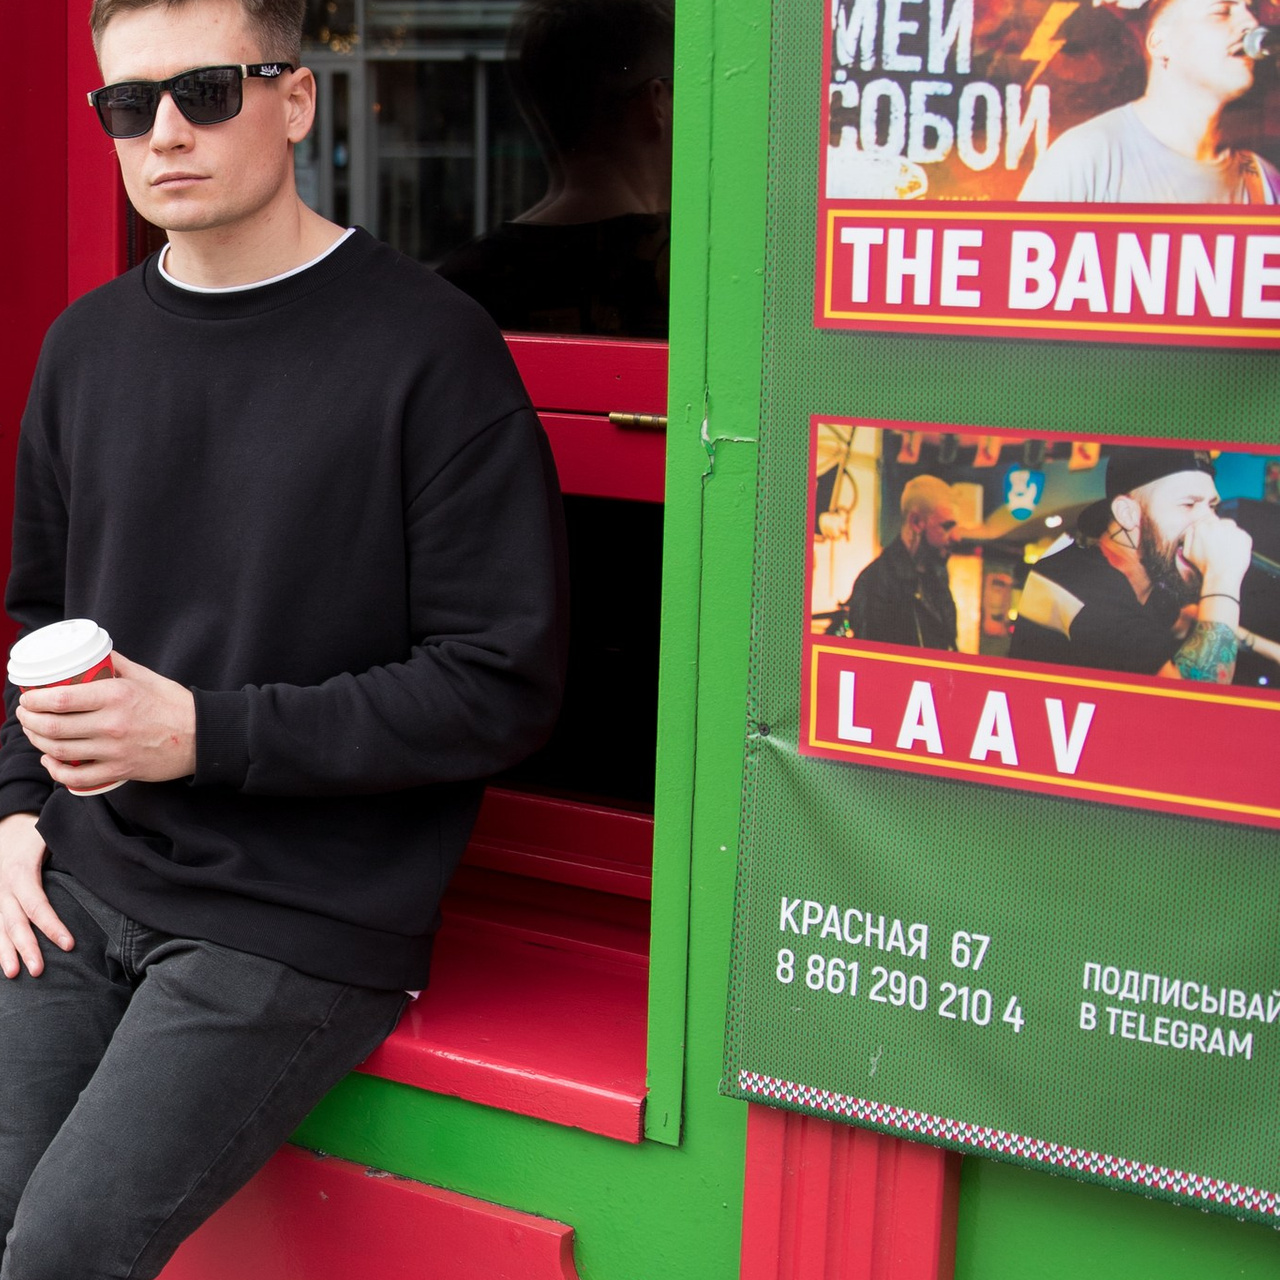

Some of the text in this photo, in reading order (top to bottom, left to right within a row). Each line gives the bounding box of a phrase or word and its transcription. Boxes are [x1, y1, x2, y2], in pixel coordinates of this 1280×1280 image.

[841, 227, 1280, 319] THE BANNE
[779, 896, 990, 971] КРАСНАЯ 67
[776, 948, 1025, 1033] 8 861 290 210 4
[1106, 1007, 1253, 1060] TELEGRAM
